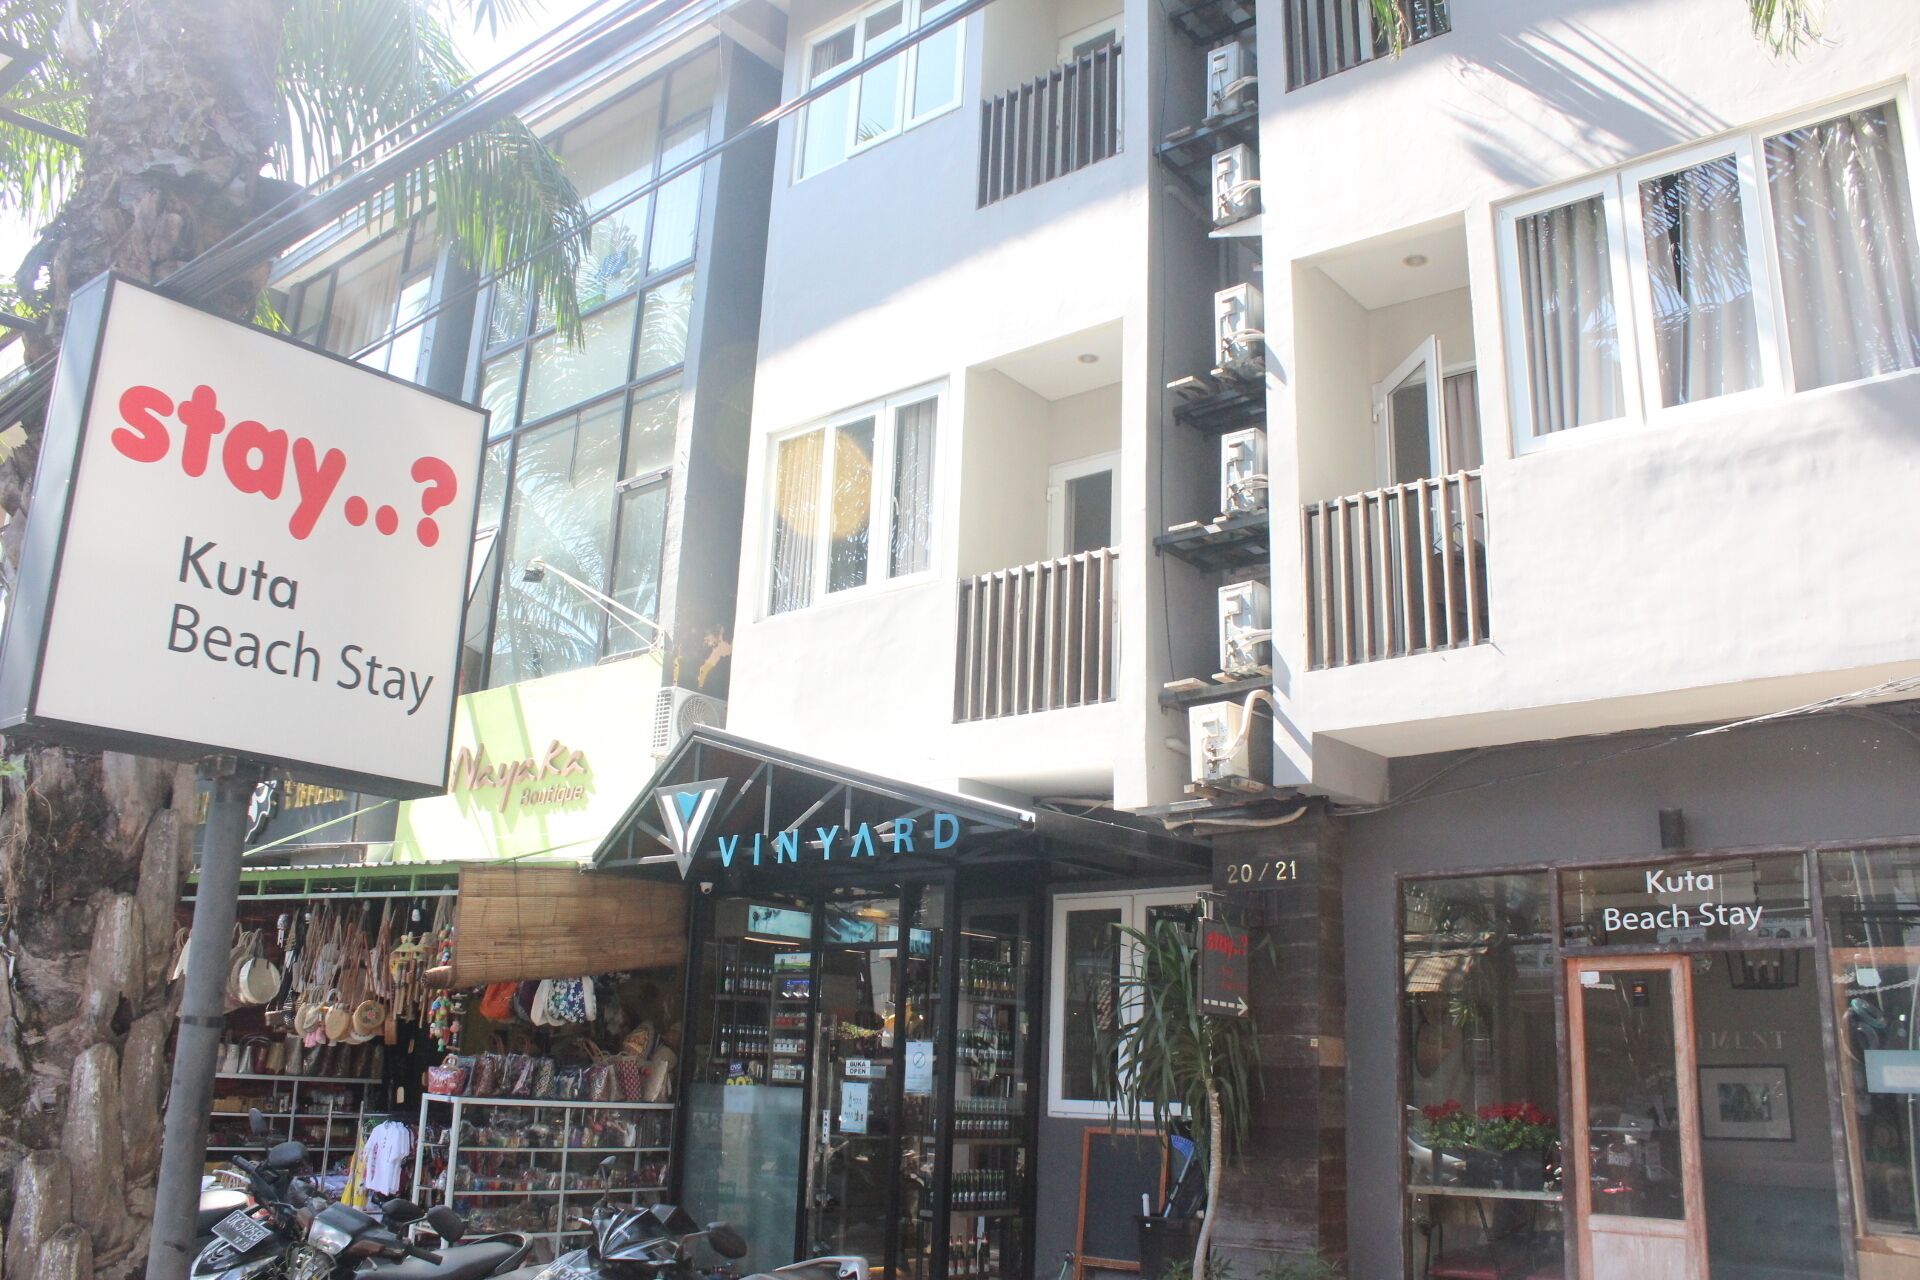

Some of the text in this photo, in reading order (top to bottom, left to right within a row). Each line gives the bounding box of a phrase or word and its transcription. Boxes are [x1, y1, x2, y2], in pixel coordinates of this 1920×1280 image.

[178, 535, 299, 610] Kuta
[167, 603, 434, 716] Beach Stay
[520, 784, 585, 806] Boutique
[718, 813, 960, 868] VINYARD
[1645, 869, 1714, 894] Kuta
[1603, 902, 1763, 931] Beach Stay
